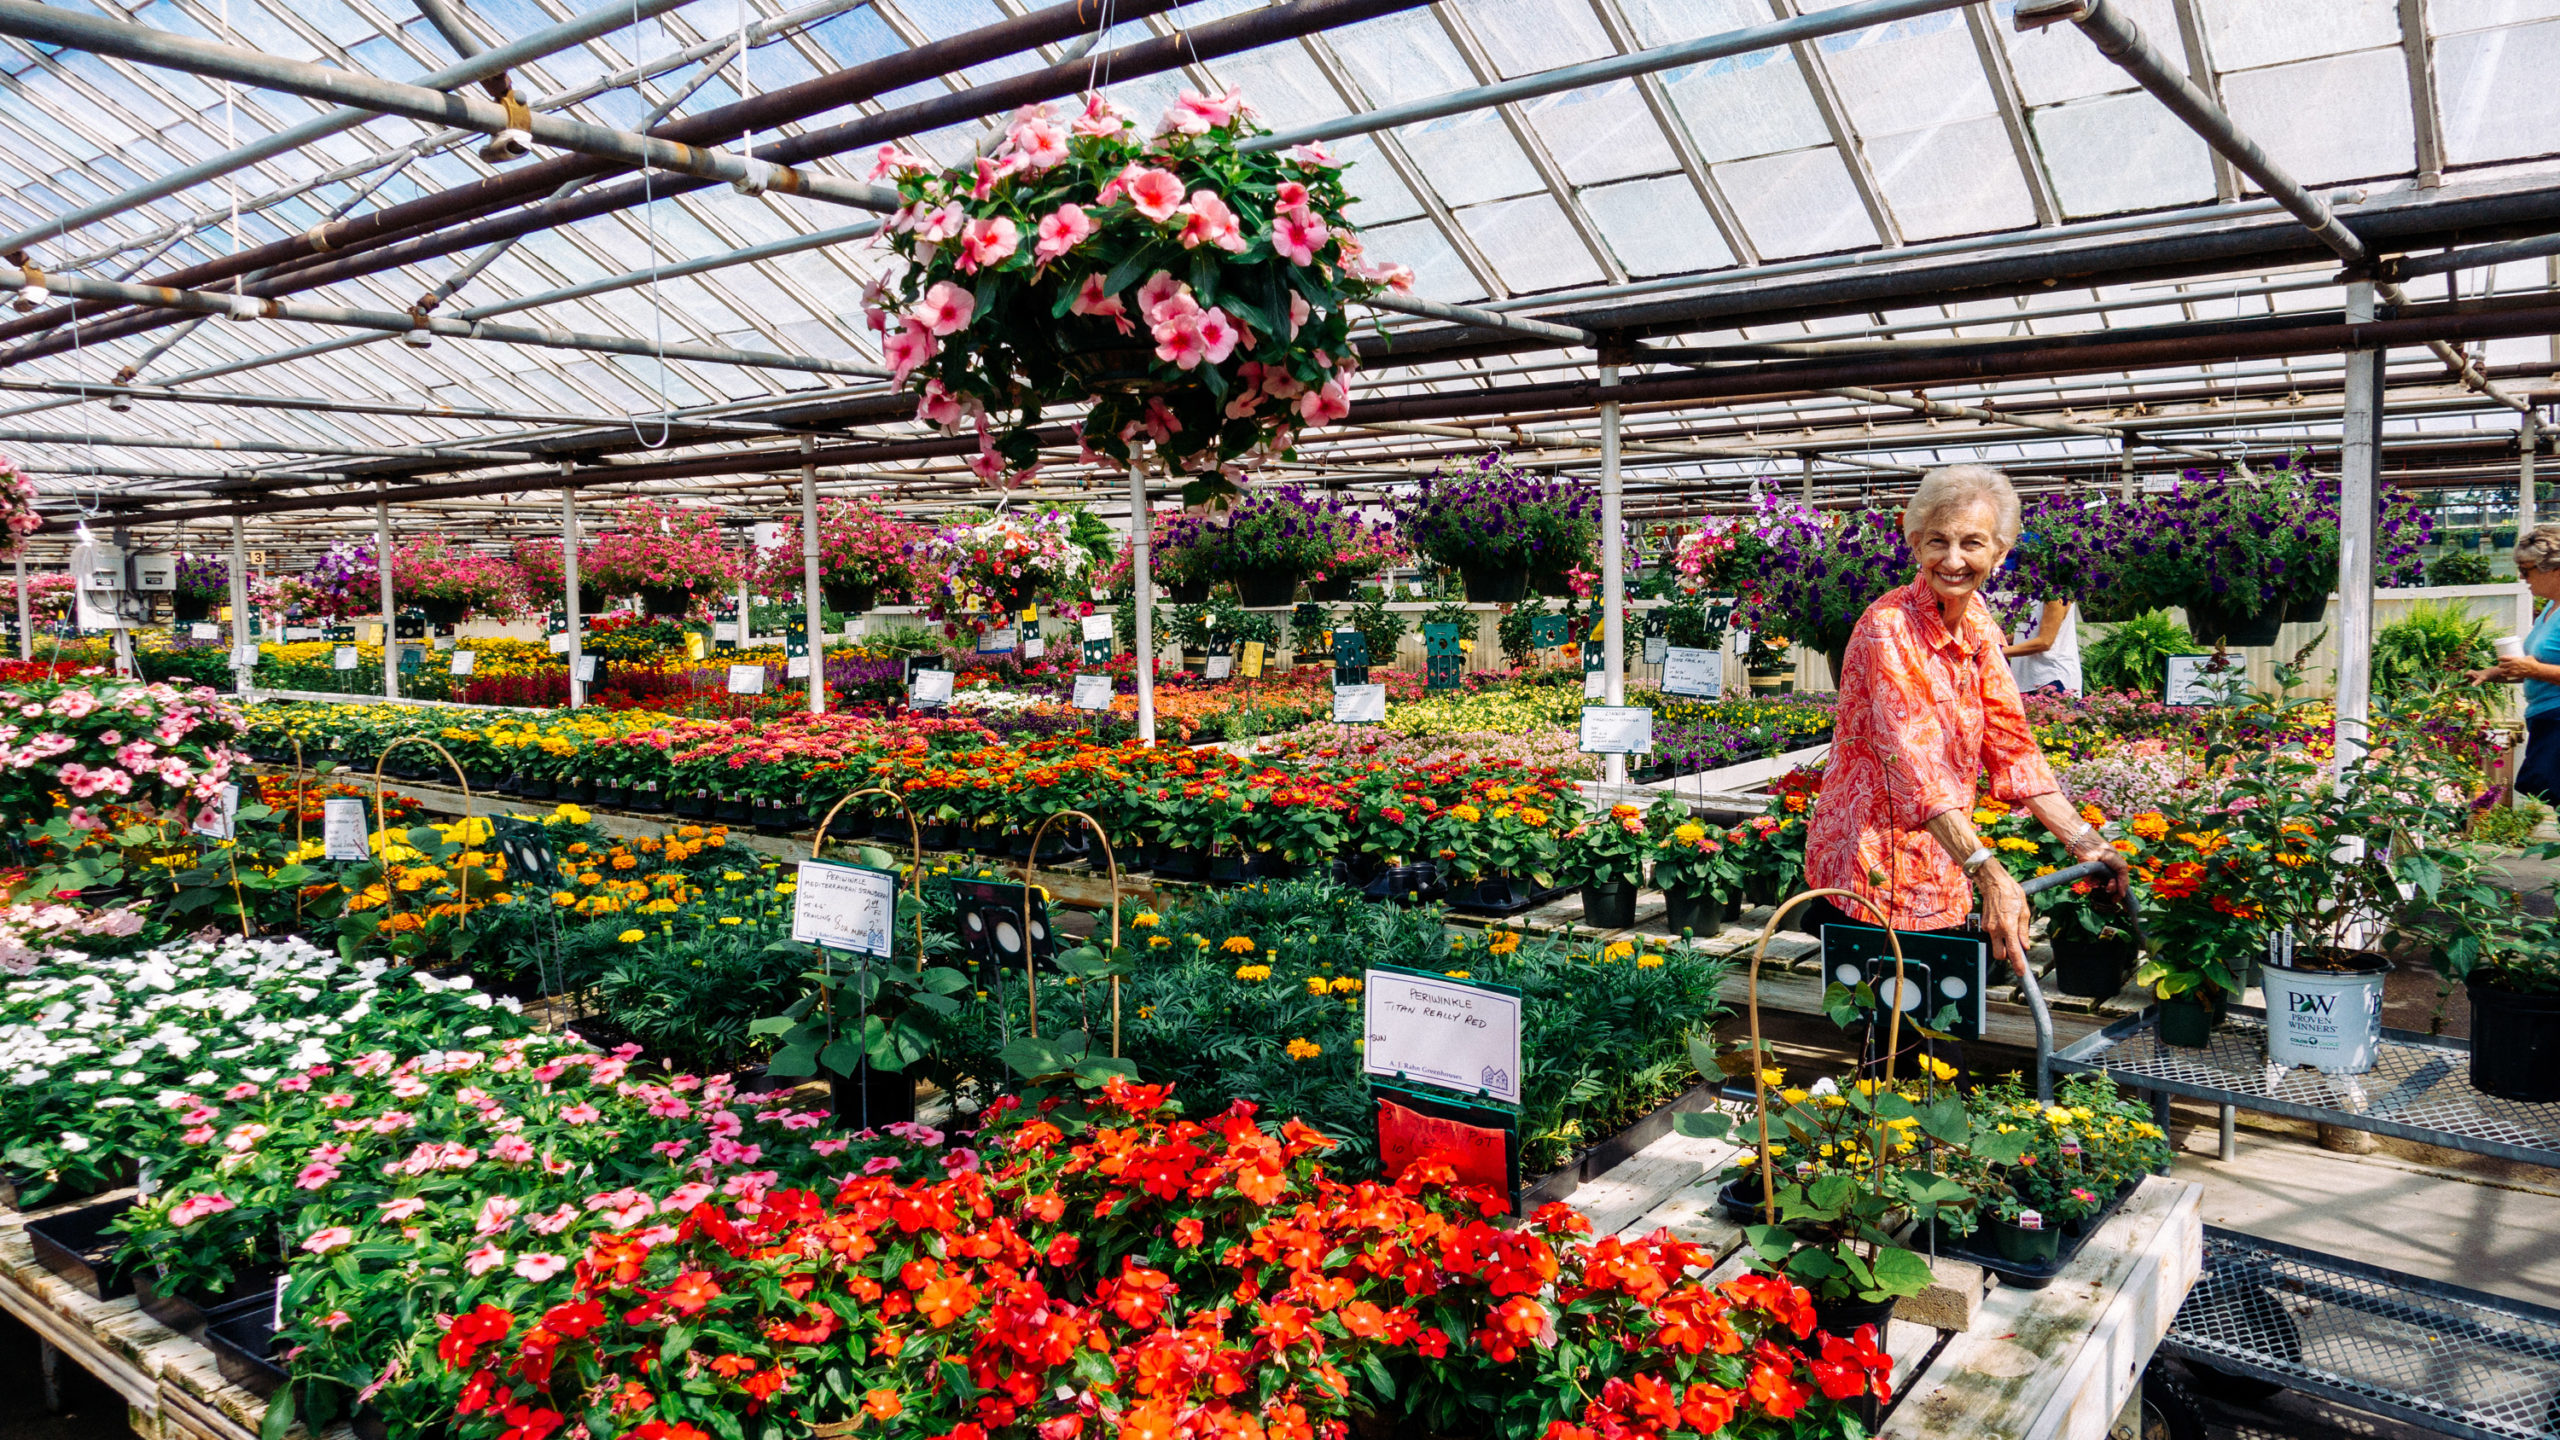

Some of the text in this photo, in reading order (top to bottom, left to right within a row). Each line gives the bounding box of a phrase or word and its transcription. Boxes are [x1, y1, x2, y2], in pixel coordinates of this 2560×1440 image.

[2145, 479, 2178, 488] CACTU
[255, 552, 262, 563] 3
[826, 871, 867, 886] PERIWINKLE
[1410, 988, 1473, 1010] PERIWINKLE
[2287, 991, 2338, 1015] PW
[1384, 1001, 1487, 1029] TITAN REALLY RED
[2291, 1013, 2332, 1025] PROVEN
[2288, 1021, 2336, 1033] WINNERS
[1403, 1062, 1421, 1072] Rahn
[1421, 1066, 1463, 1081] Greenhouses
[1468, 1130, 1499, 1148] POT
